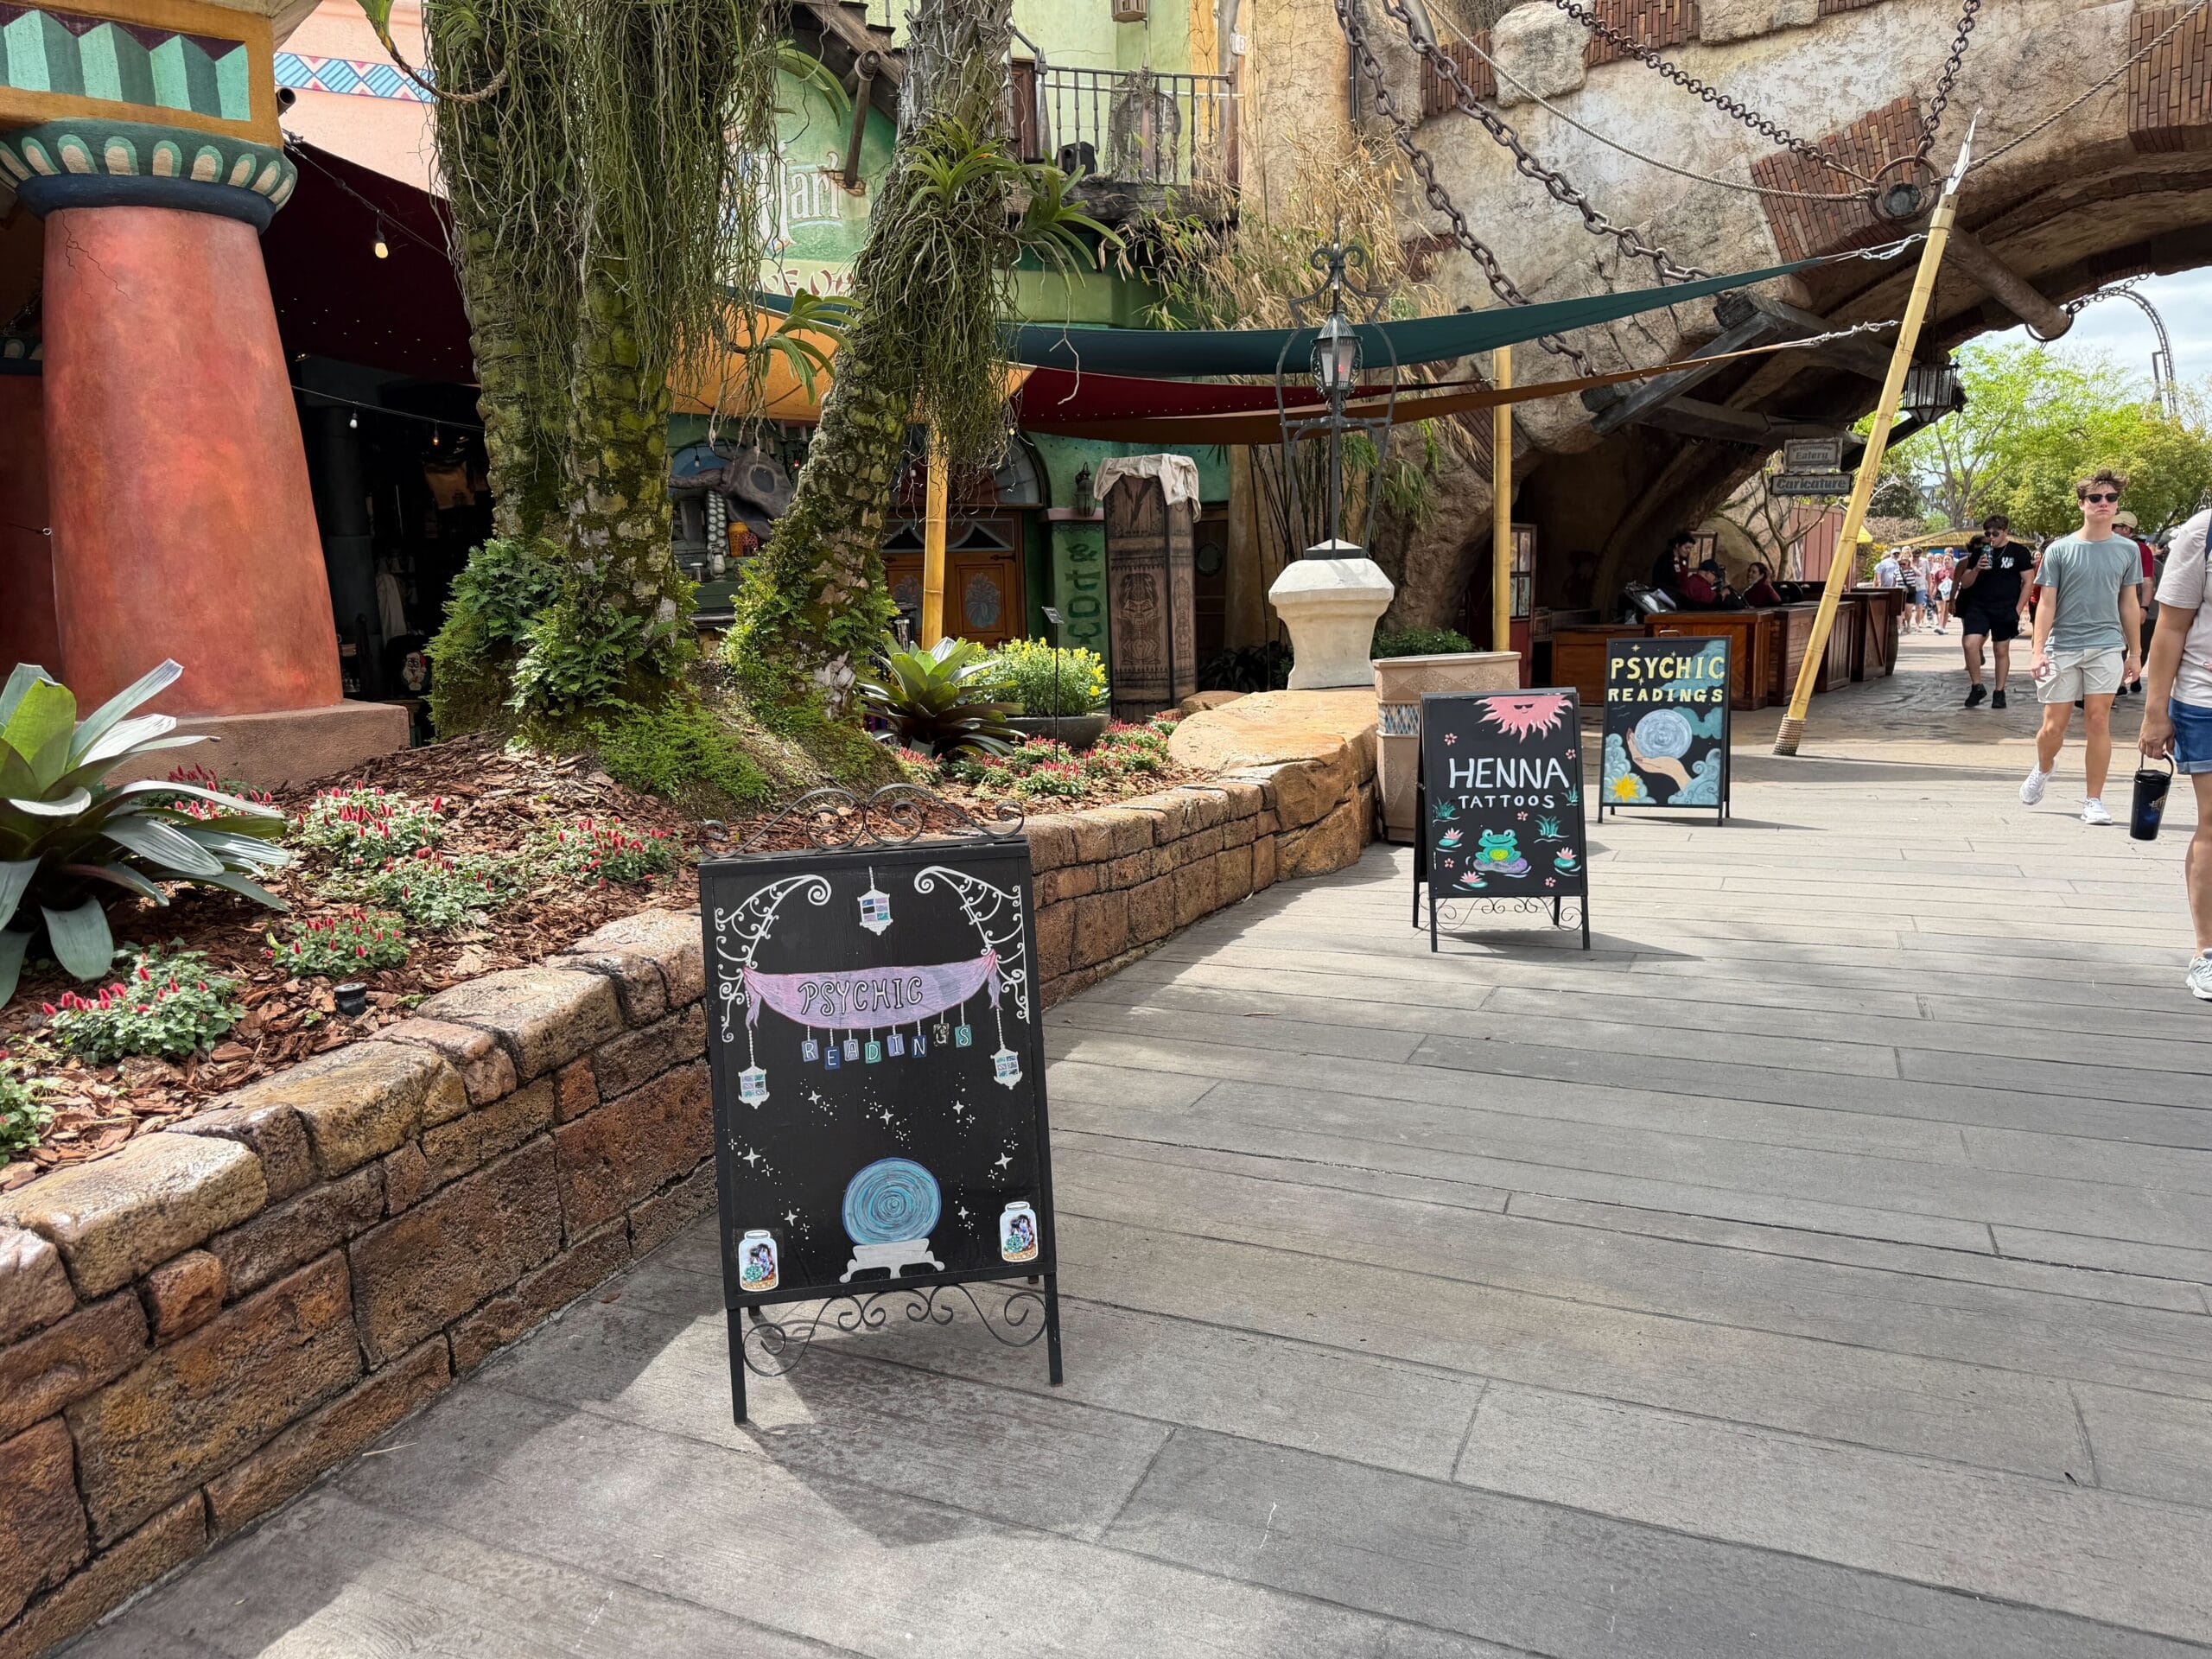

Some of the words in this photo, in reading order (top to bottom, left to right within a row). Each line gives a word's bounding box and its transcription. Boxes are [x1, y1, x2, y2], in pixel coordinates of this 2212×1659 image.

[1776, 477, 1847, 489] Caricature
[1610, 655, 1726, 681] PSYCHIC
[1607, 687, 1724, 703] READINGS
[1448, 757, 1570, 790] HENNA
[1457, 794, 1555, 810] TATTOOS
[797, 976, 925, 1016] PSYCHIC
[803, 1025, 972, 1068] READINGS
